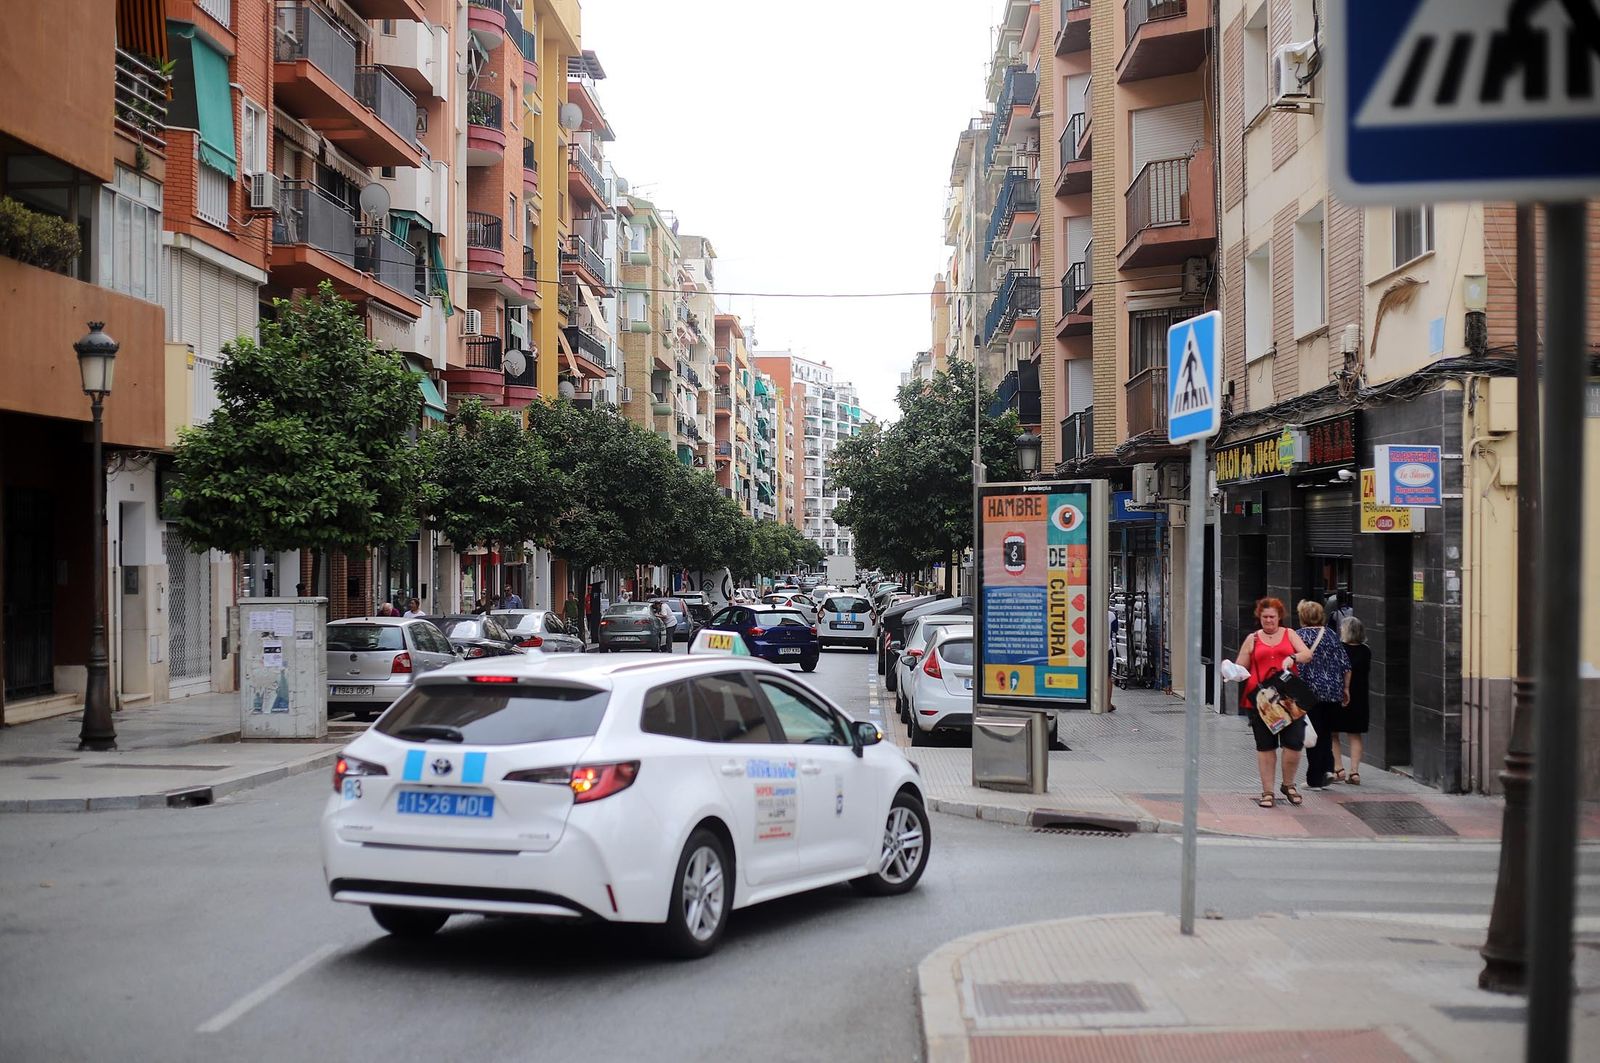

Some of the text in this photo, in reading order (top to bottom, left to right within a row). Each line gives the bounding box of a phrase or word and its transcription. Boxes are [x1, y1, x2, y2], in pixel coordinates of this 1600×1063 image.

[1216, 448, 1240, 480] SALON
[1241, 446, 1252, 480] de
[1363, 475, 1375, 498] ZA
[988, 497, 1042, 517] HAMBRE
[1049, 548, 1066, 567] DE
[1050, 578, 1066, 656] CULTURA
[708, 634, 732, 650] TAXI
[409, 793, 490, 816] 1526 MDL
